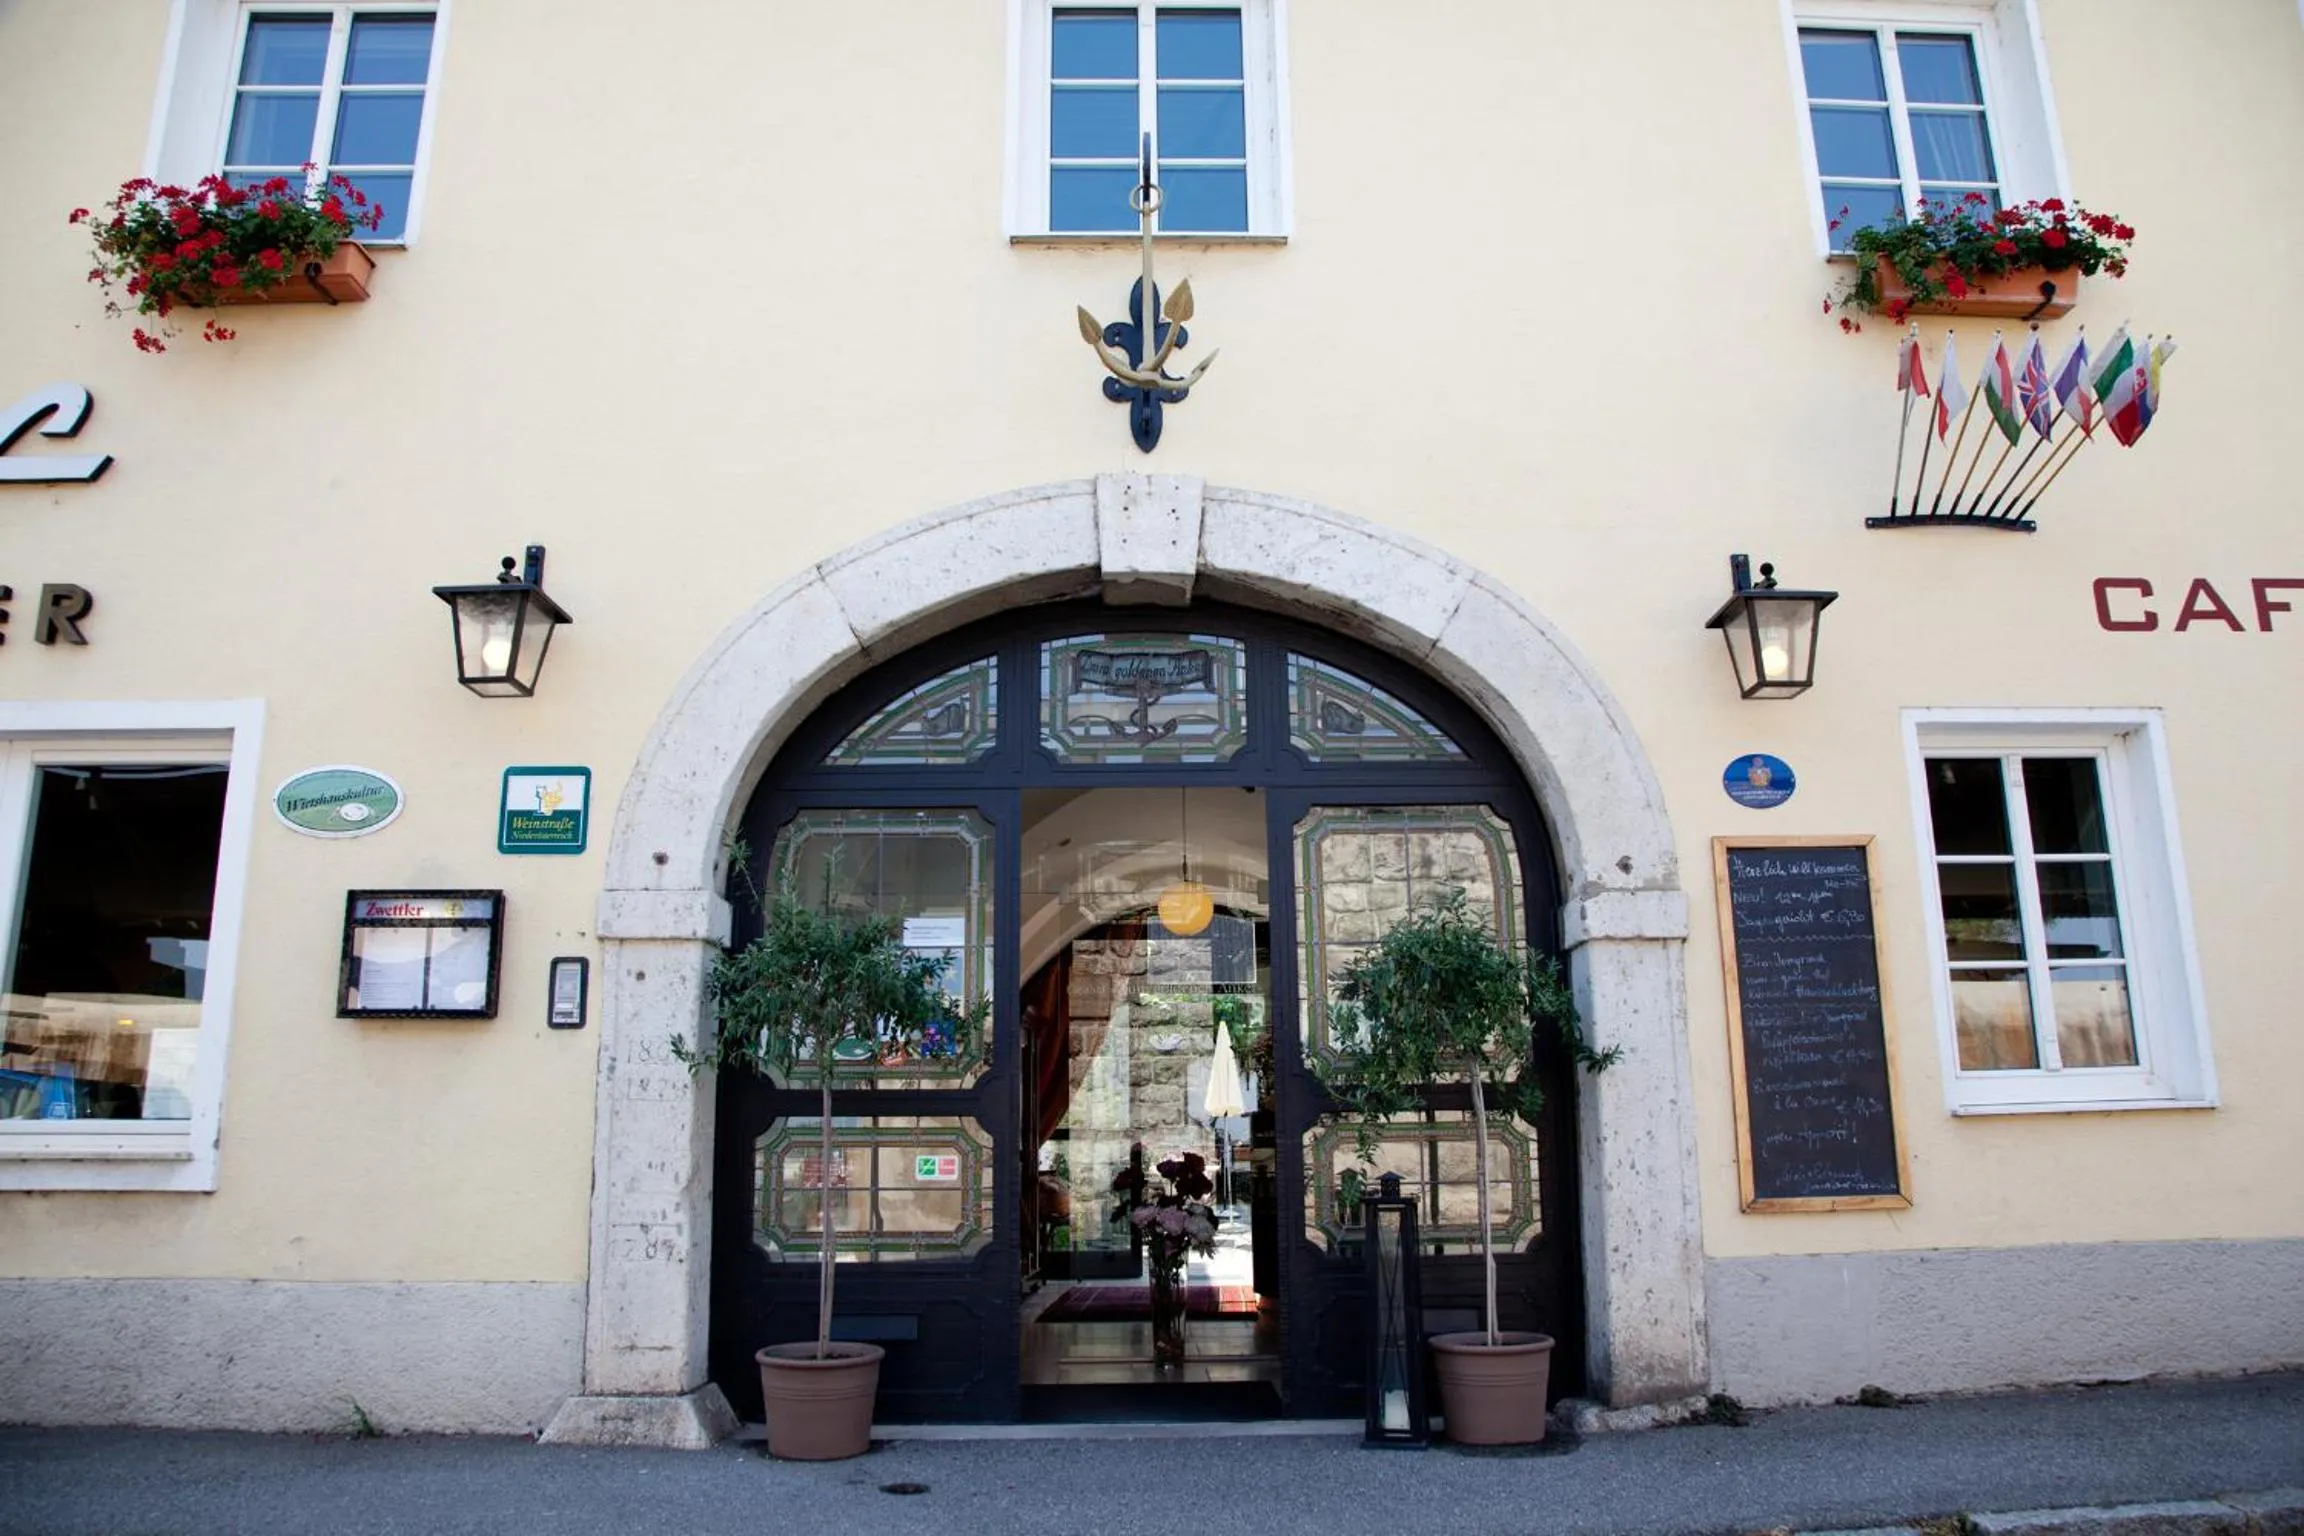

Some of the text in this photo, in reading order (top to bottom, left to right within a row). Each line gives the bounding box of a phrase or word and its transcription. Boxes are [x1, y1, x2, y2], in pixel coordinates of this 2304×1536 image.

[0, 583, 93, 645] R
[2093, 577, 2304, 632] CAF
[366, 901, 425, 917] Zwettler
